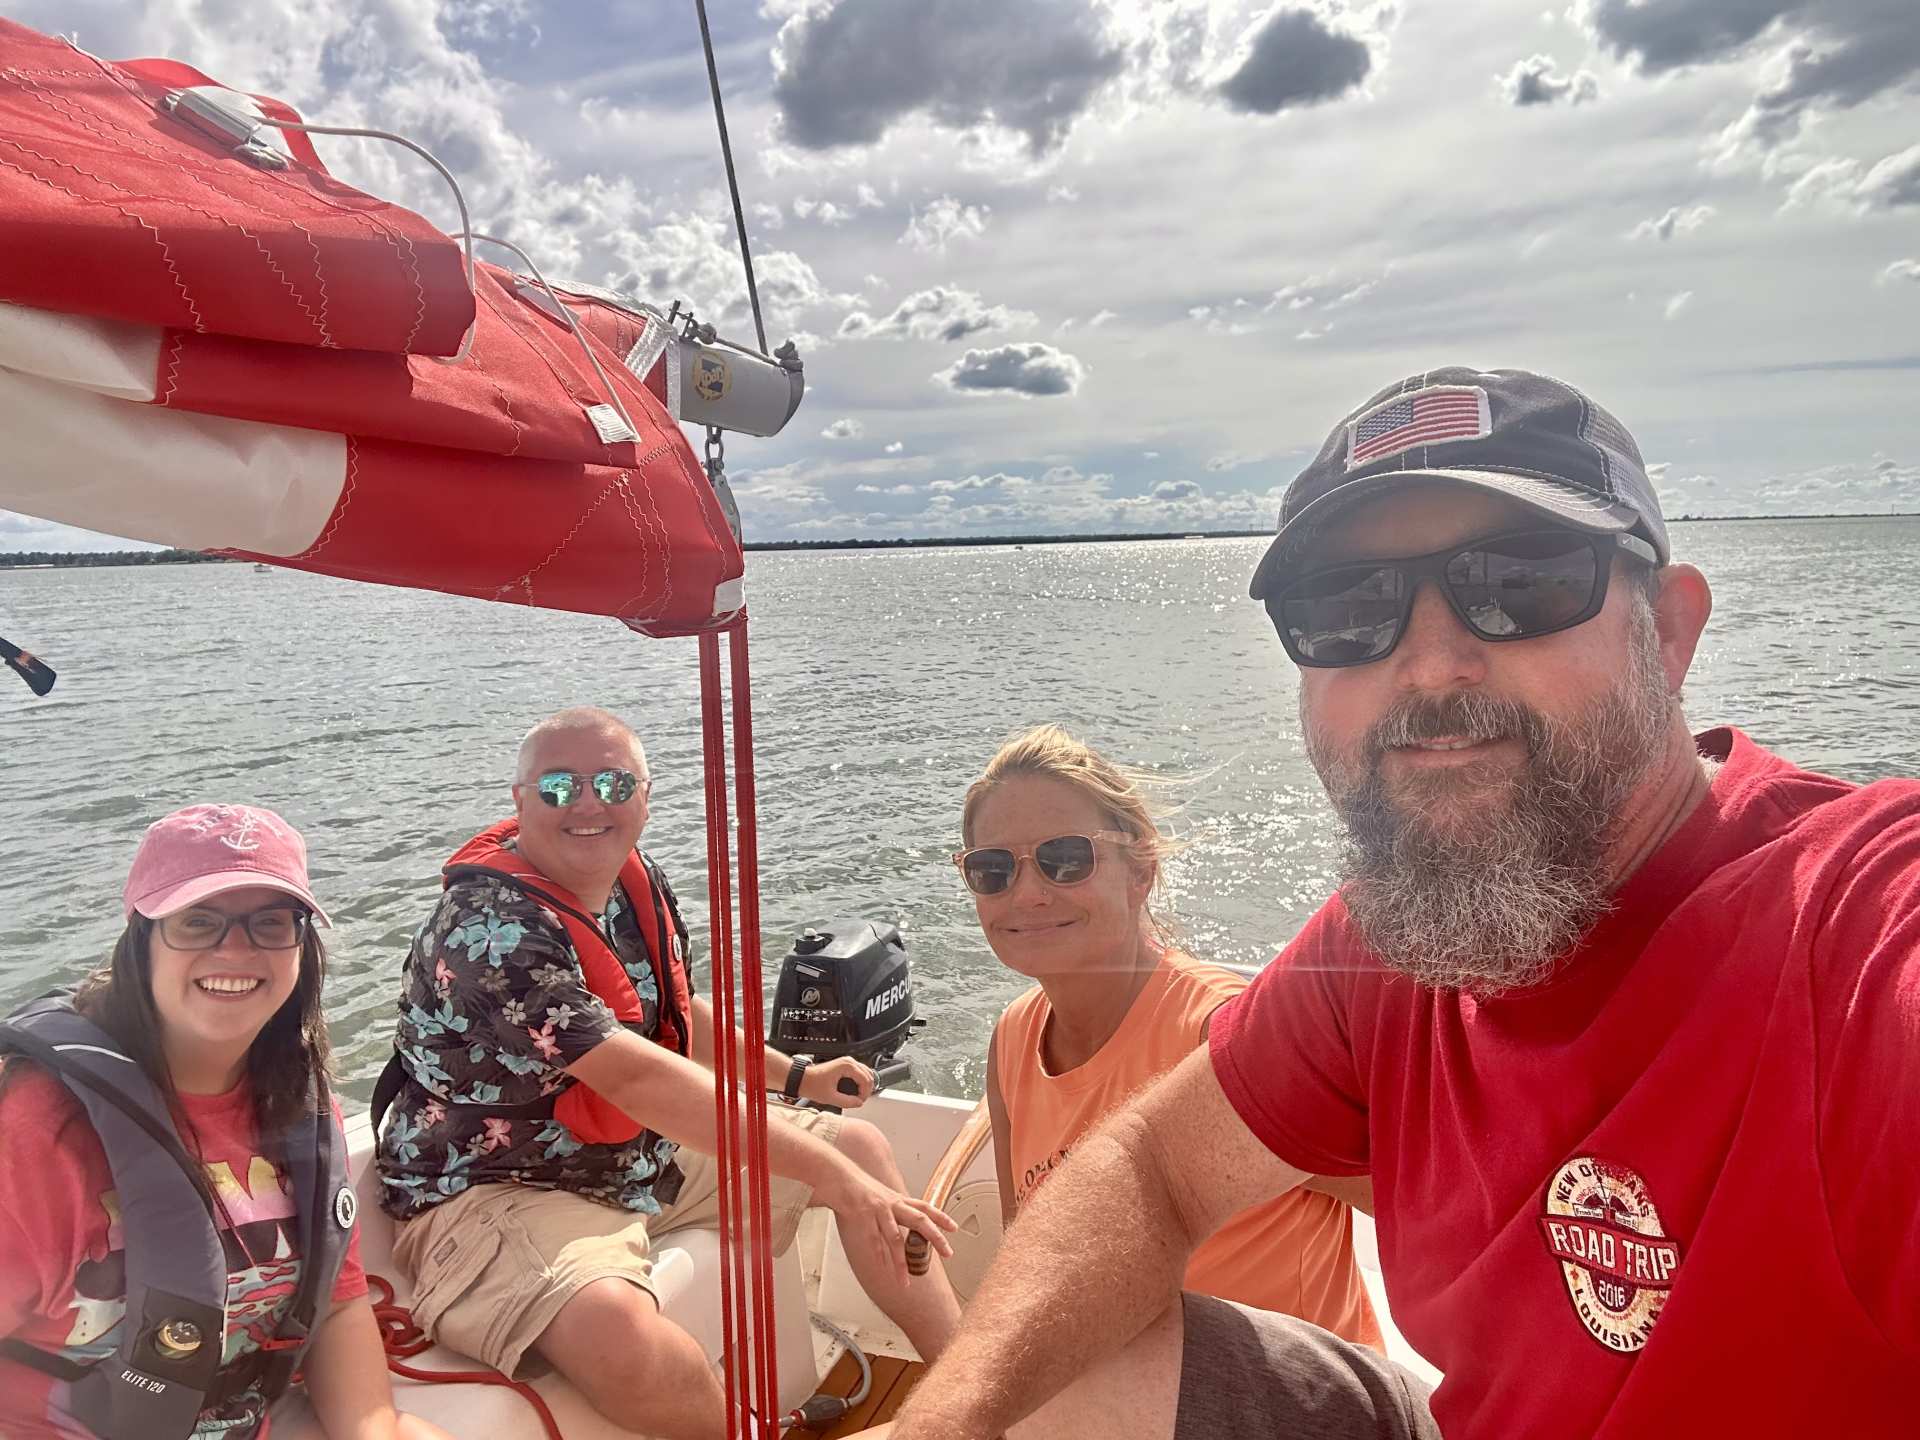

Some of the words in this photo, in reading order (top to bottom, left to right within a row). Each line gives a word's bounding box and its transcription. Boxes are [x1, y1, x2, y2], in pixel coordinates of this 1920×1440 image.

[865, 976, 911, 1020] MERCU
[1556, 1170, 1578, 1204] NEW
[1578, 1163, 1650, 1218] OANS
[1548, 1222, 1615, 1269] ROAD
[1622, 1239, 1677, 1280] TRIP
[1598, 1279, 1625, 1308] 2016
[120, 1370, 148, 1388] ELITE
[146, 1380, 166, 1393] 120
